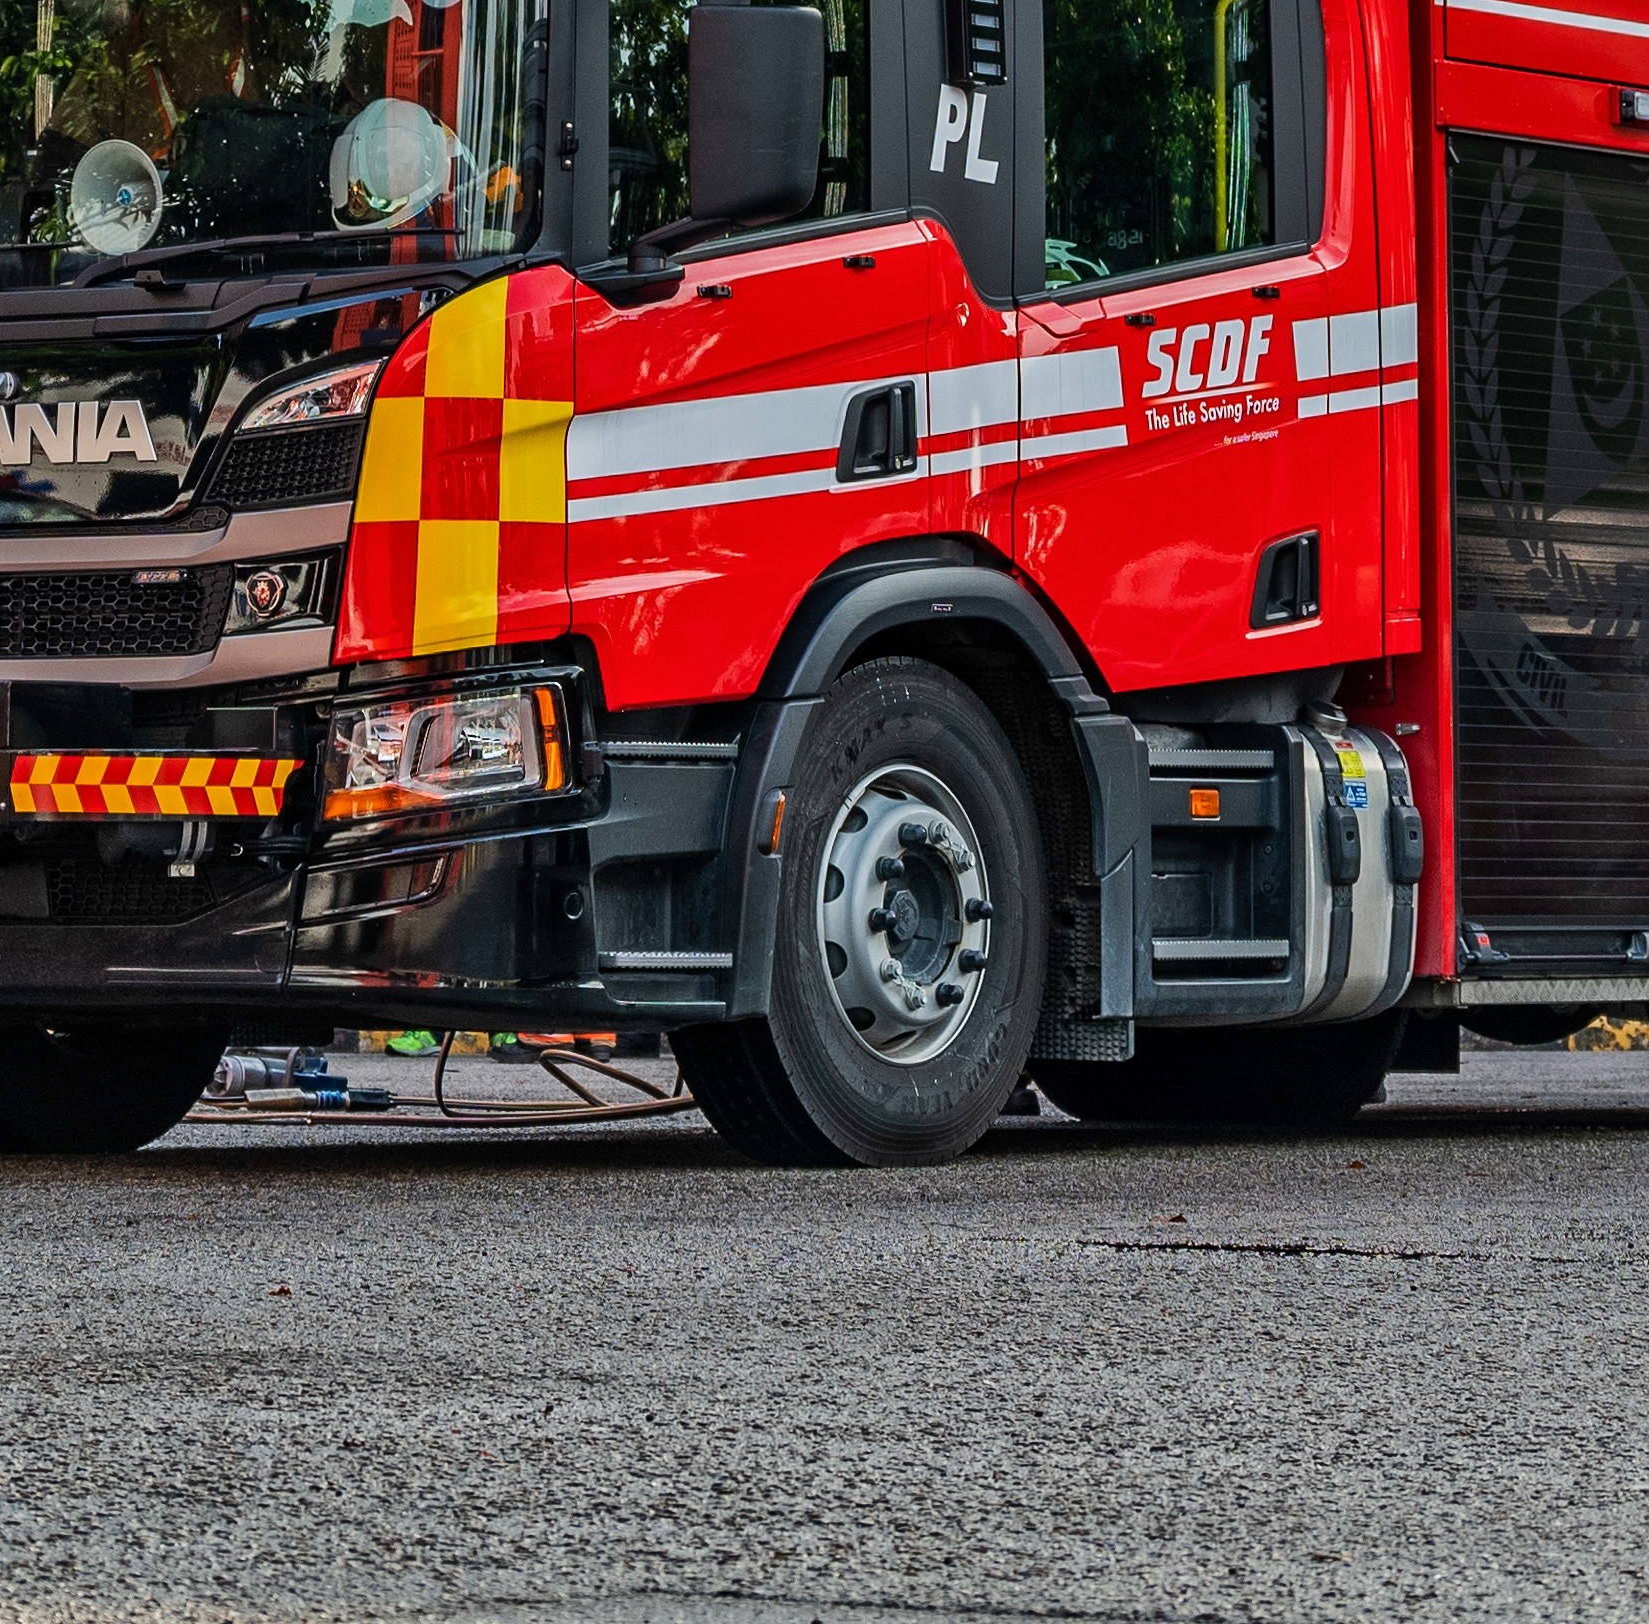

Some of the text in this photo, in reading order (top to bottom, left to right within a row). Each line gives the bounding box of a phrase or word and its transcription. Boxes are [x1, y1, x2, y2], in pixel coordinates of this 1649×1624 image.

[930, 84, 1000, 185] PL
[1141, 313, 1274, 398] SCDF
[1145, 394, 1280, 431] The Life Saving Force
[1251, 429, 1279, 442] Singapore
